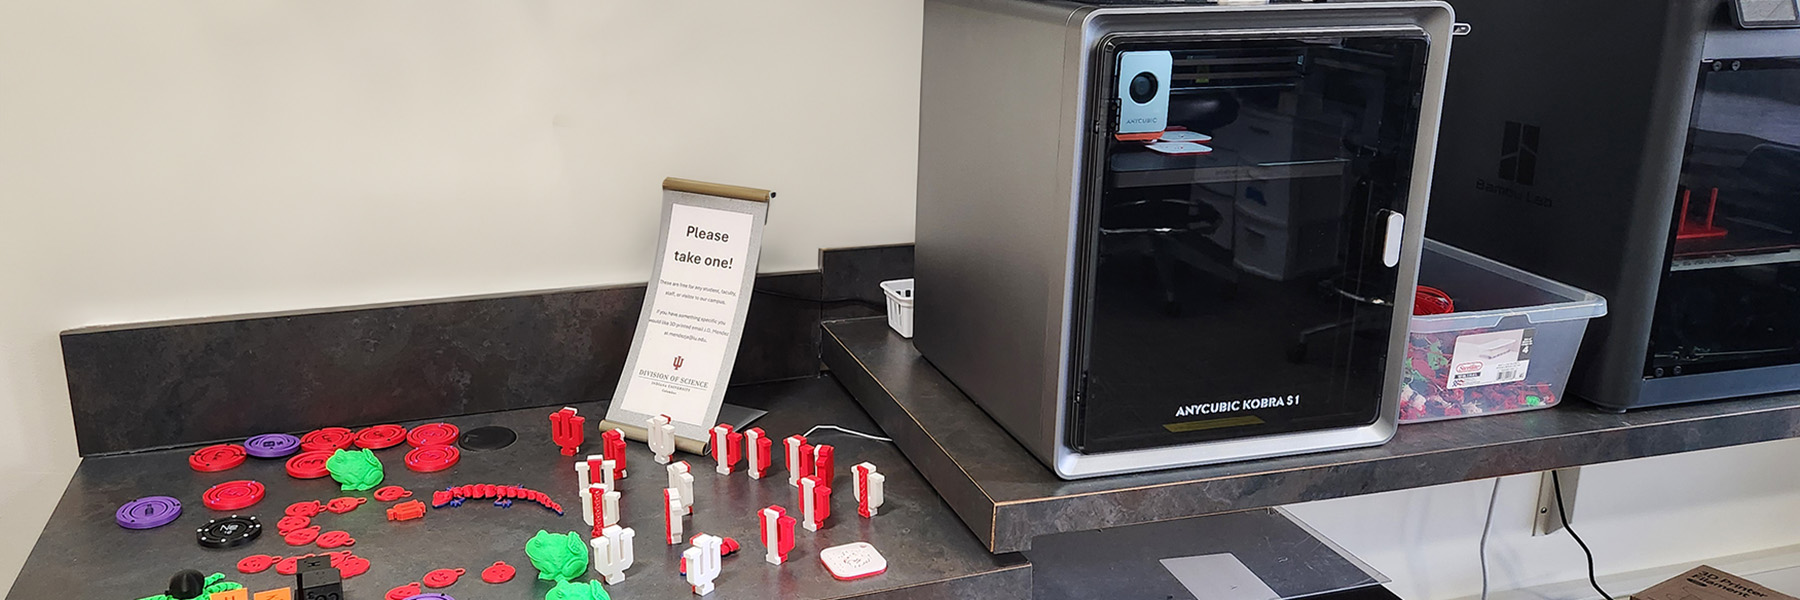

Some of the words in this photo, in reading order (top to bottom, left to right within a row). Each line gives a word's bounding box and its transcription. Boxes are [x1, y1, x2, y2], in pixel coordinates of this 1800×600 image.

[686, 225, 730, 243] Please
[673, 250, 702, 265] take
[704, 257, 734, 270] one!
[638, 369, 669, 381] DIVISION
[679, 377, 709, 389] SCIENCE
[1175, 400, 1241, 417] ANYCUBIC
[1242, 396, 1285, 411] KOBRA
[1692, 573, 1750, 598] Filament
[1698, 570, 1719, 580] 3D
[1720, 578, 1768, 598] Printer
